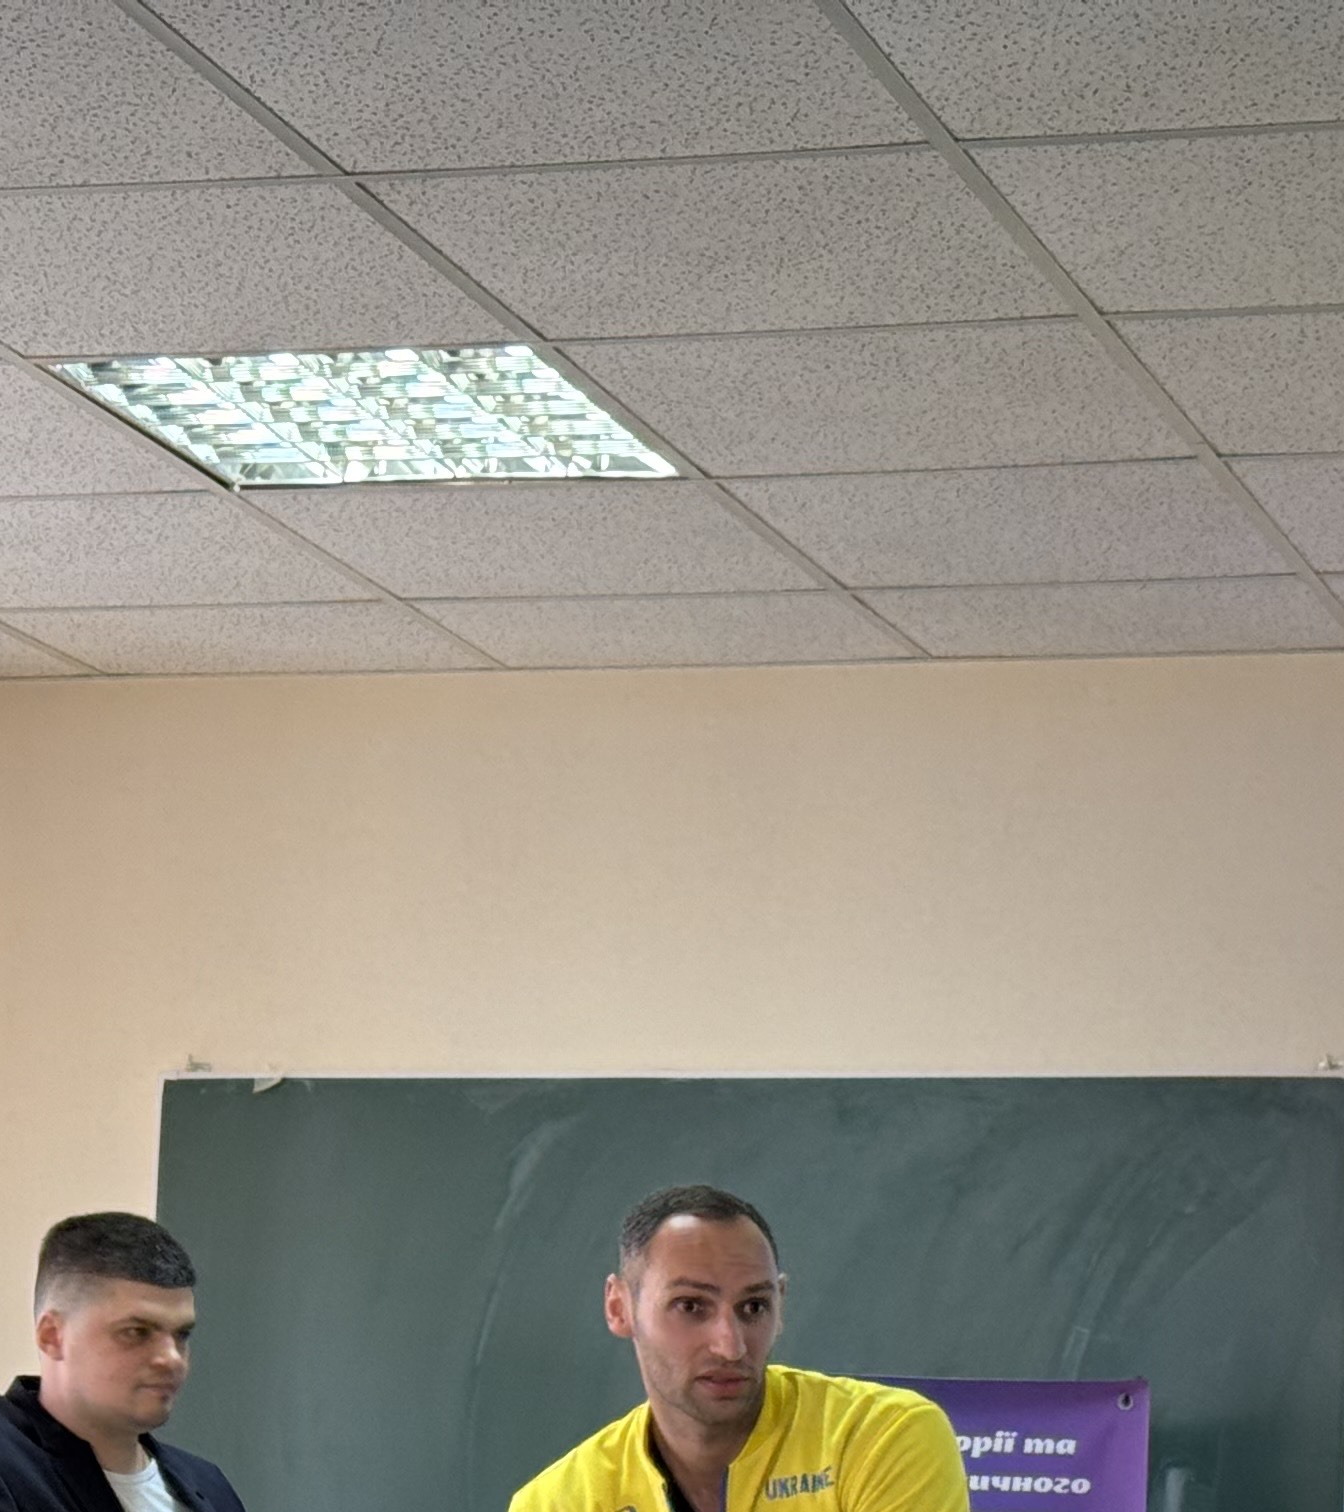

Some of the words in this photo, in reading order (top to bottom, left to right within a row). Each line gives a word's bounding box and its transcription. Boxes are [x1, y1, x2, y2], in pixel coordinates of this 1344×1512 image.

[1023, 1437, 1077, 1456] та
[765, 1465, 835, 1501] UKRAINE
[969, 1474, 1091, 1494] ичного
